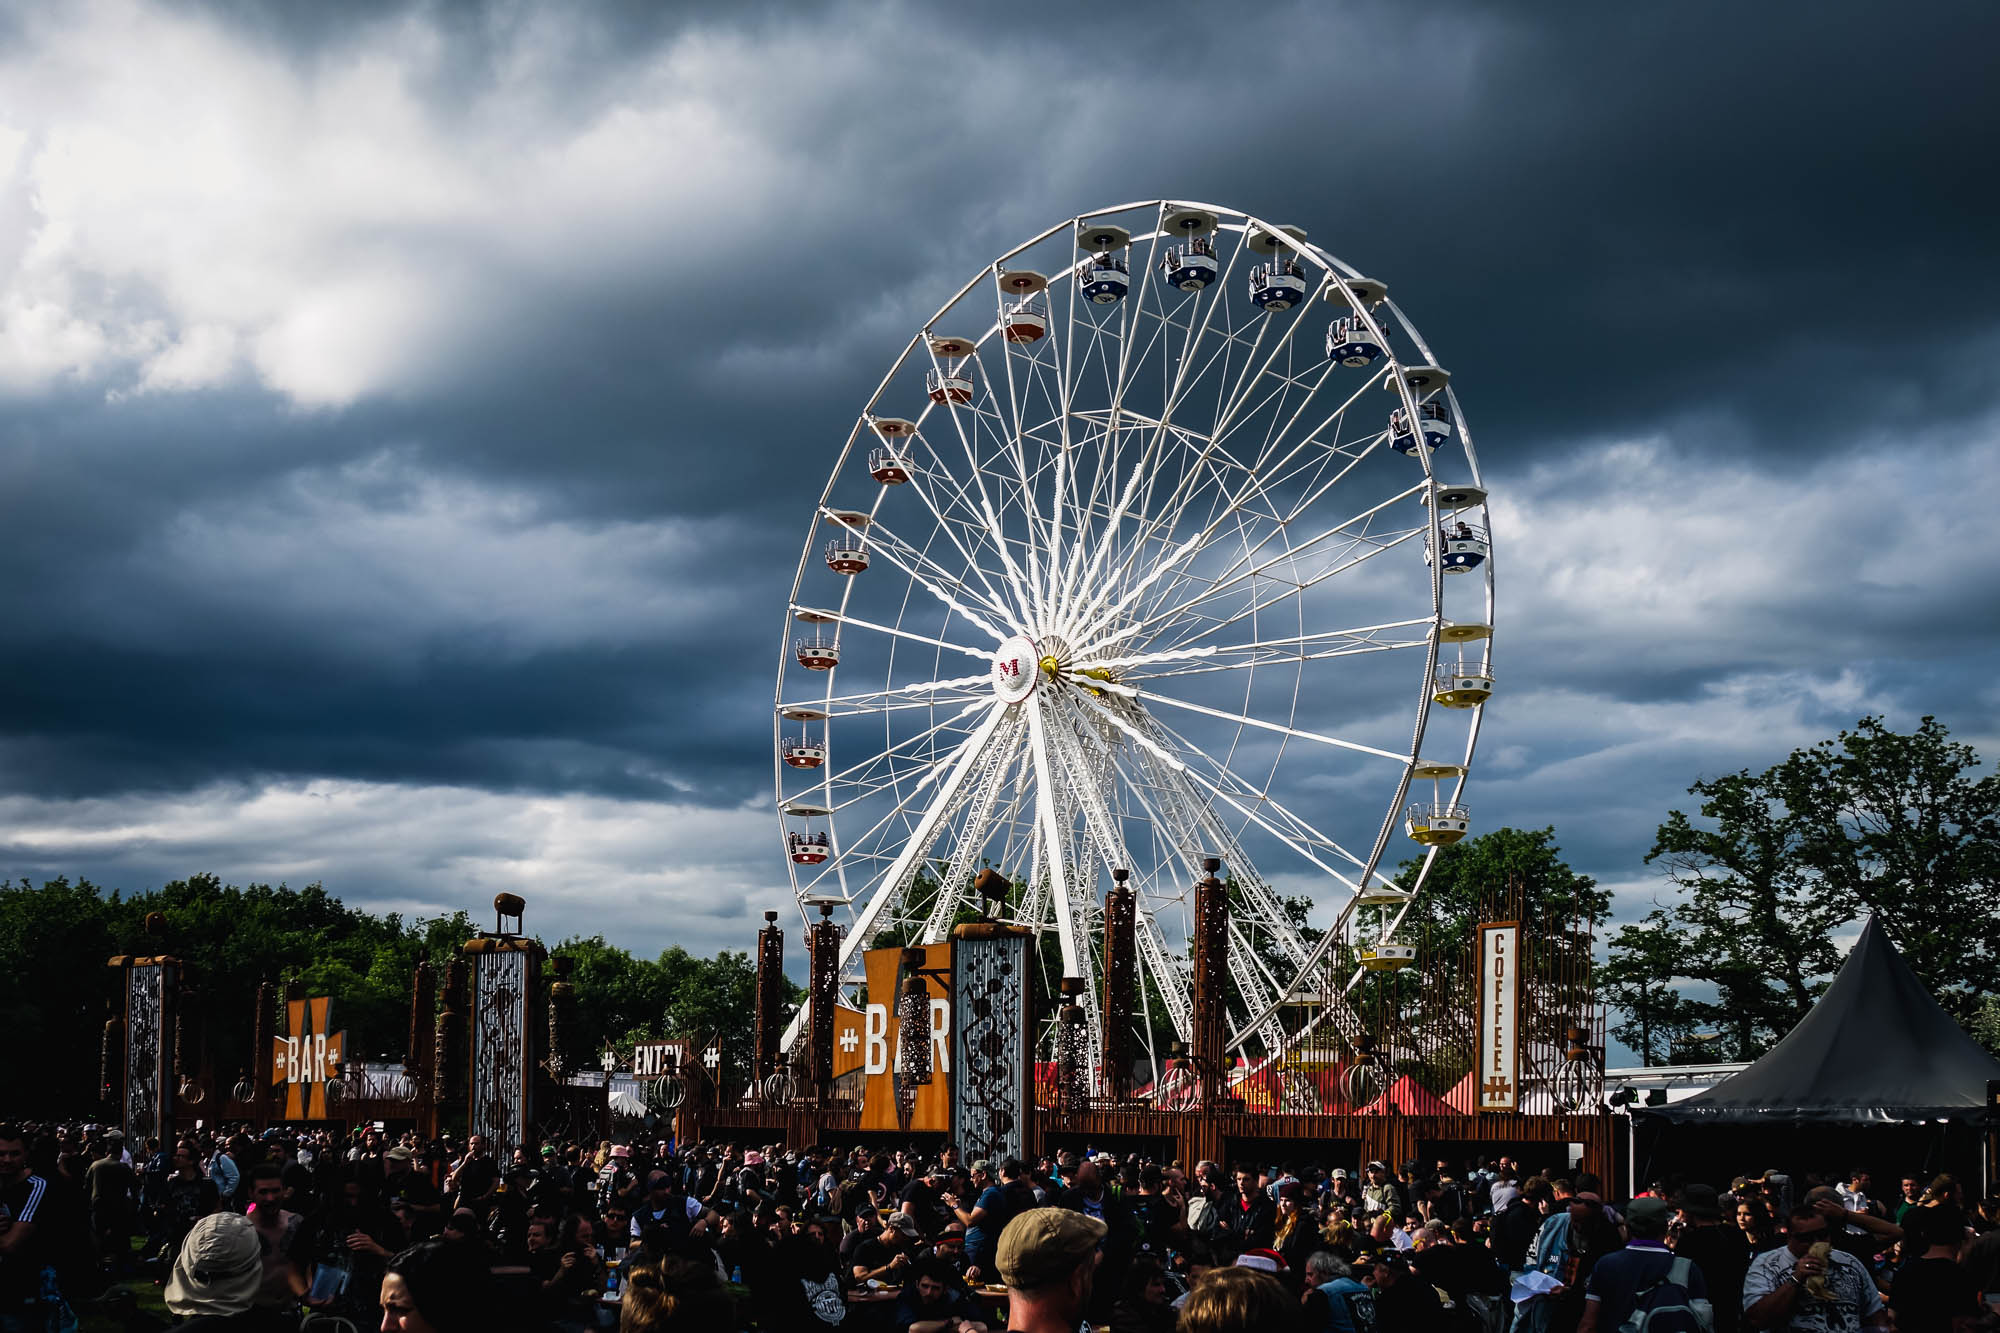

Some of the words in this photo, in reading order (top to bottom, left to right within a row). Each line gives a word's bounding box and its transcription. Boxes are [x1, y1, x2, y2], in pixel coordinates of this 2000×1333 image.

[1000, 658, 1020, 681] M
[1493, 933, 1505, 1072] COFFEE
[287, 1033, 327, 1084] BAR
[864, 998, 951, 1076] BR
